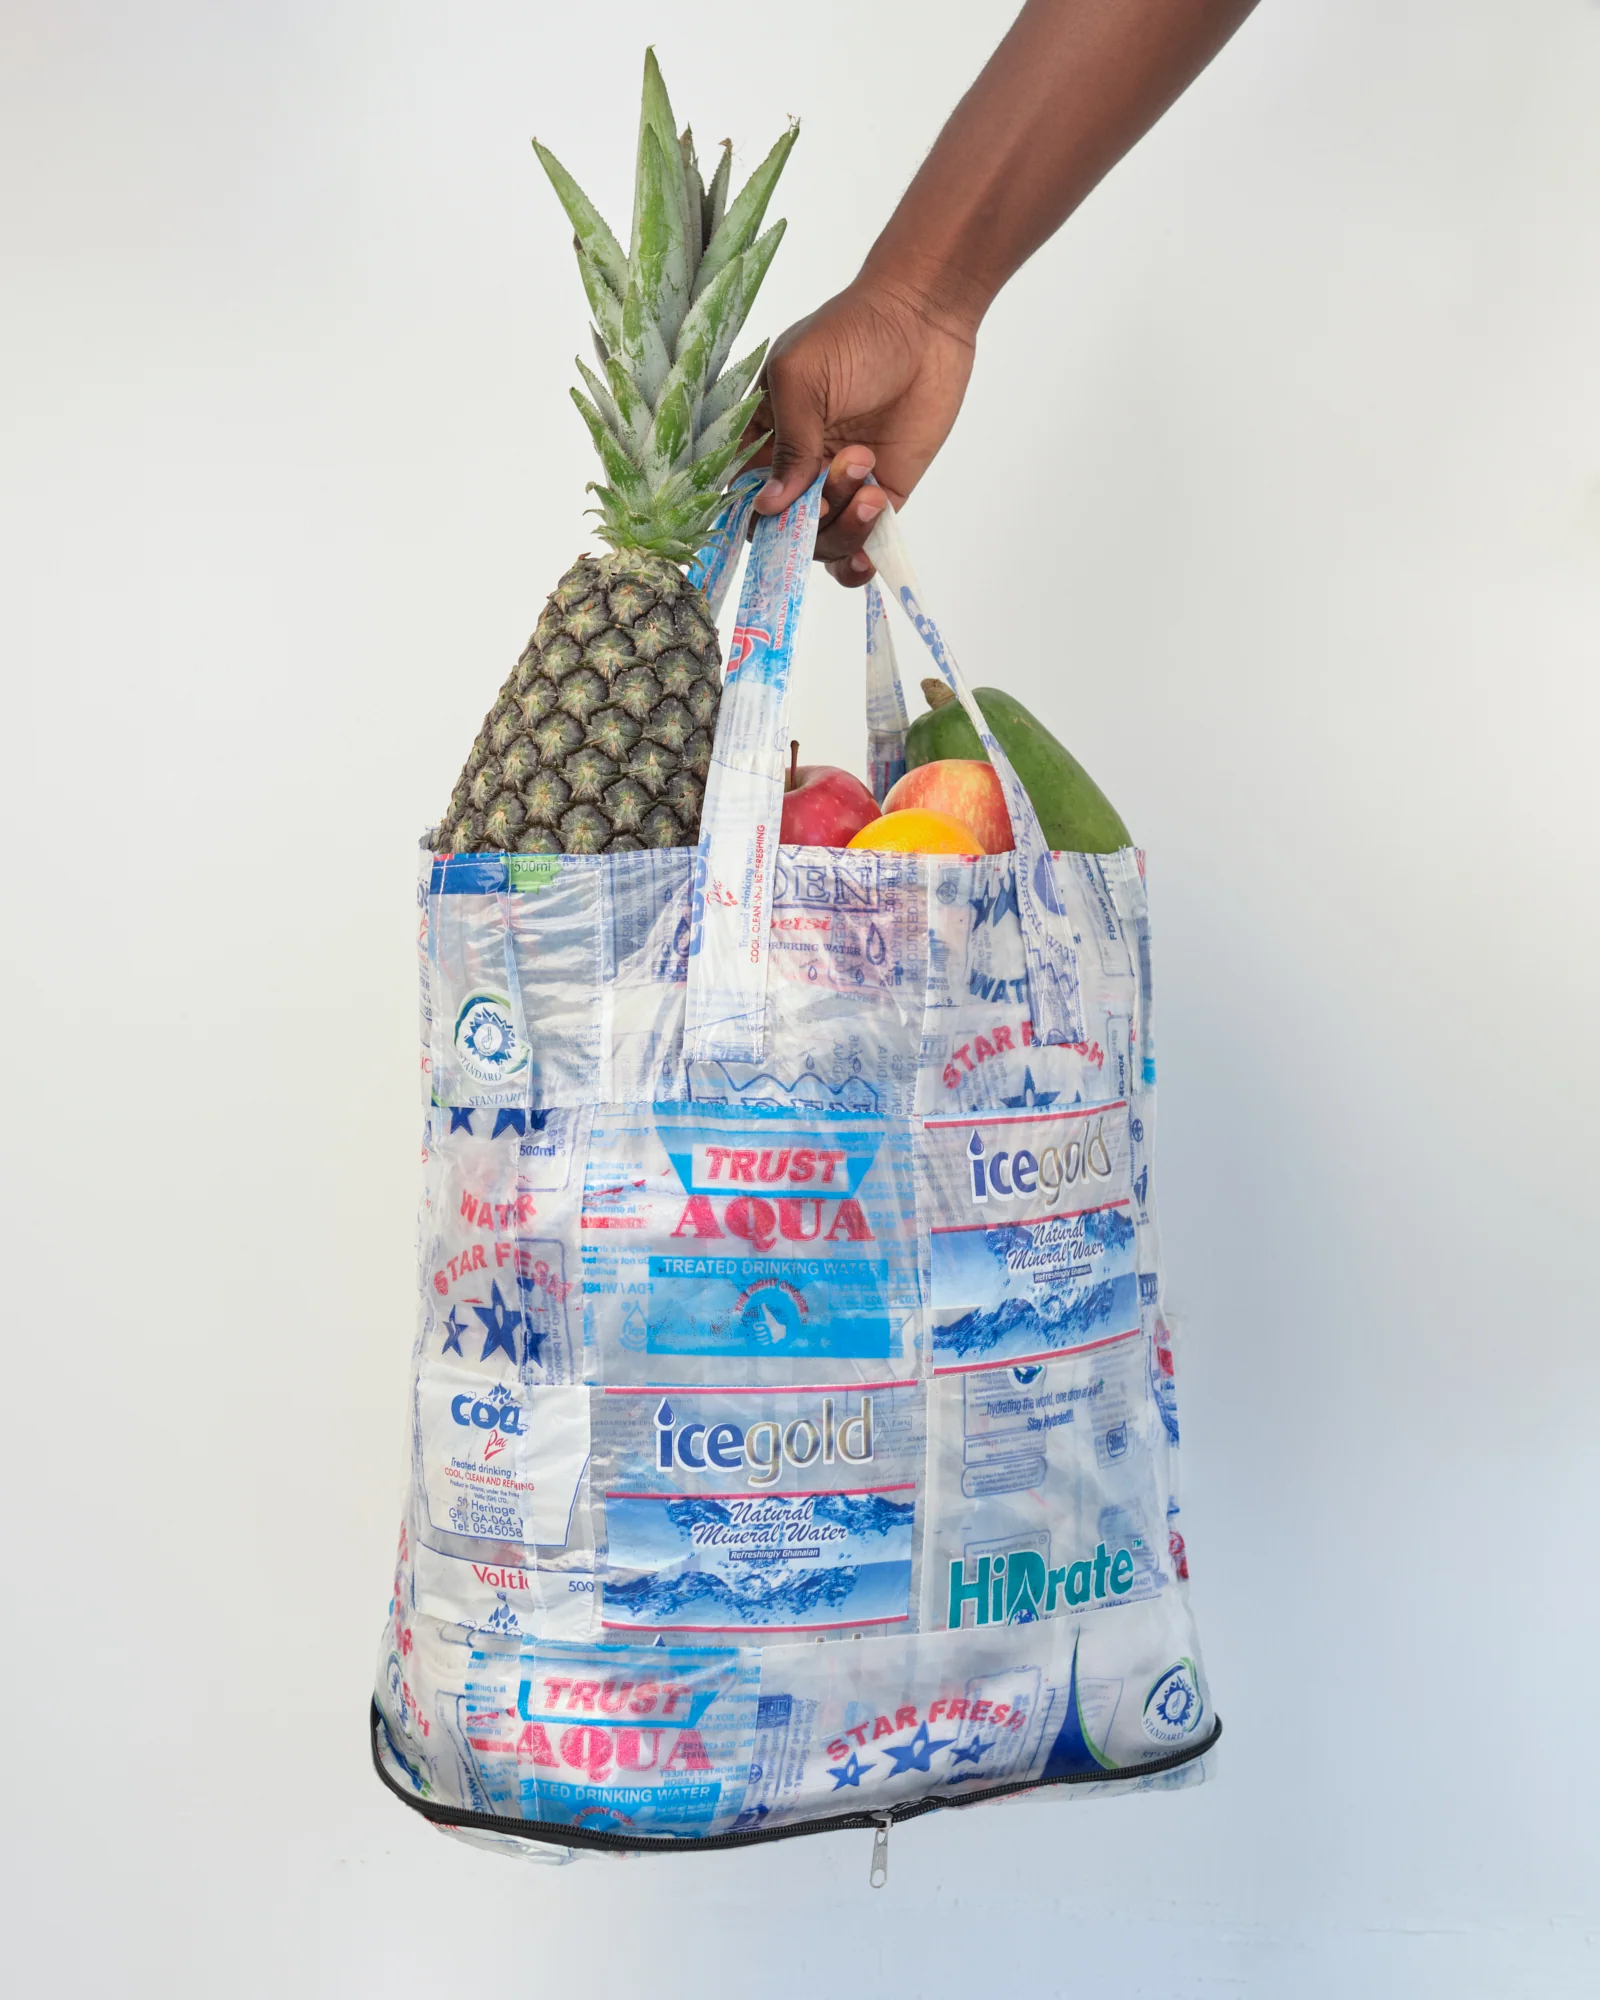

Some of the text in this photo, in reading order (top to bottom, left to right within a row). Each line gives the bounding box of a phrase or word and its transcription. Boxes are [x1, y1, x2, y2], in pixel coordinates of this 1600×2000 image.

[774, 599, 788, 648] NATURAL
[784, 547, 798, 593] MINERAL
[793, 503, 807, 541] WATER
[969, 968, 1027, 1004] WAT
[456, 1051, 502, 1081] STANDARD
[942, 1025, 1016, 1090] STAR
[704, 1147, 847, 1185] TRUST
[968, 1117, 1112, 1205] icegold
[669, 1194, 877, 1253] AQUA
[1032, 1217, 1085, 1246] Natural
[433, 1243, 488, 1296] STAR
[662, 1258, 738, 1275] TREATED
[741, 1259, 820, 1276] DRINKING
[1007, 1242, 1068, 1270] Mineral
[1022, 1396, 1035, 1410] the
[1035, 1392, 1055, 1408] world,
[1055, 1391, 1067, 1404] one
[1027, 1416, 1042, 1432] Stay
[484, 1429, 509, 1456] Pac
[655, 1397, 874, 1486] icegold
[444, 1467, 465, 1481] COOL,
[465, 1472, 486, 1485] CLEAN
[486, 1475, 502, 1487] AND
[450, 1456, 513, 1479] Treated drinking
[471, 1500, 516, 1516] Heritage
[729, 1501, 815, 1524] Natural
[452, 1519, 524, 1538] Tel: 0545058
[692, 1523, 848, 1547] Mineral Water
[730, 1547, 819, 1560] Refreshingly Ghanaian
[568, 1580, 595, 1593] 500
[542, 1677, 692, 1716] TRUST
[826, 1704, 918, 1761] STAR
[927, 1699, 1028, 1731] FRESH
[1142, 1717, 1184, 1741] STANDARD
[516, 1722, 714, 1784] AQUA
[575, 1783, 652, 1804] DRINKING
[656, 1785, 710, 1801] WATER
